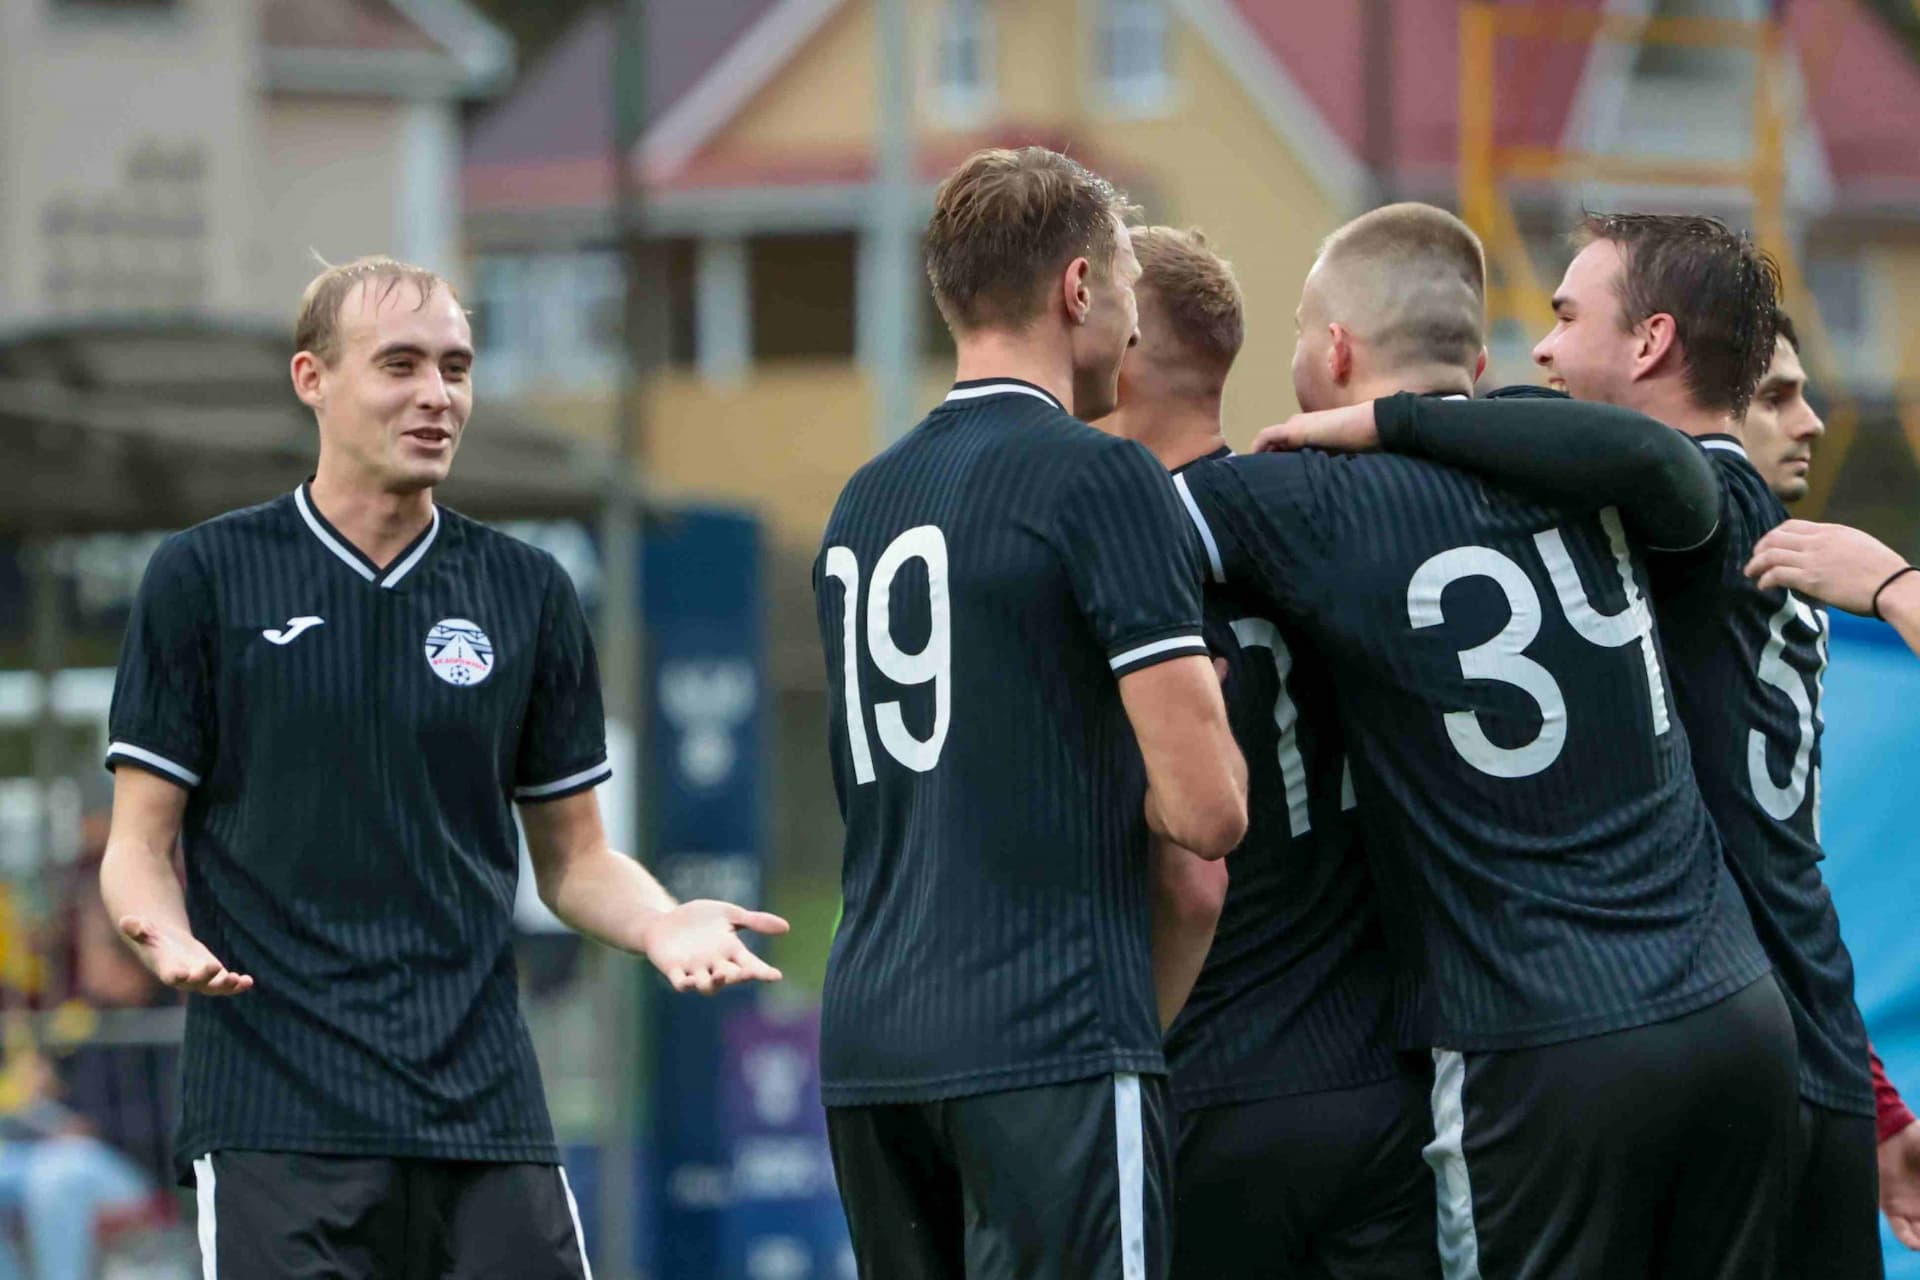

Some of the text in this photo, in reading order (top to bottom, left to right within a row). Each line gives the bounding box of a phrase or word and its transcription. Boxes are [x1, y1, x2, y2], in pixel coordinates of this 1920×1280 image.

[825, 525, 950, 784] 19
[1229, 617, 1358, 838] 1
[1407, 505, 1671, 777] 34
